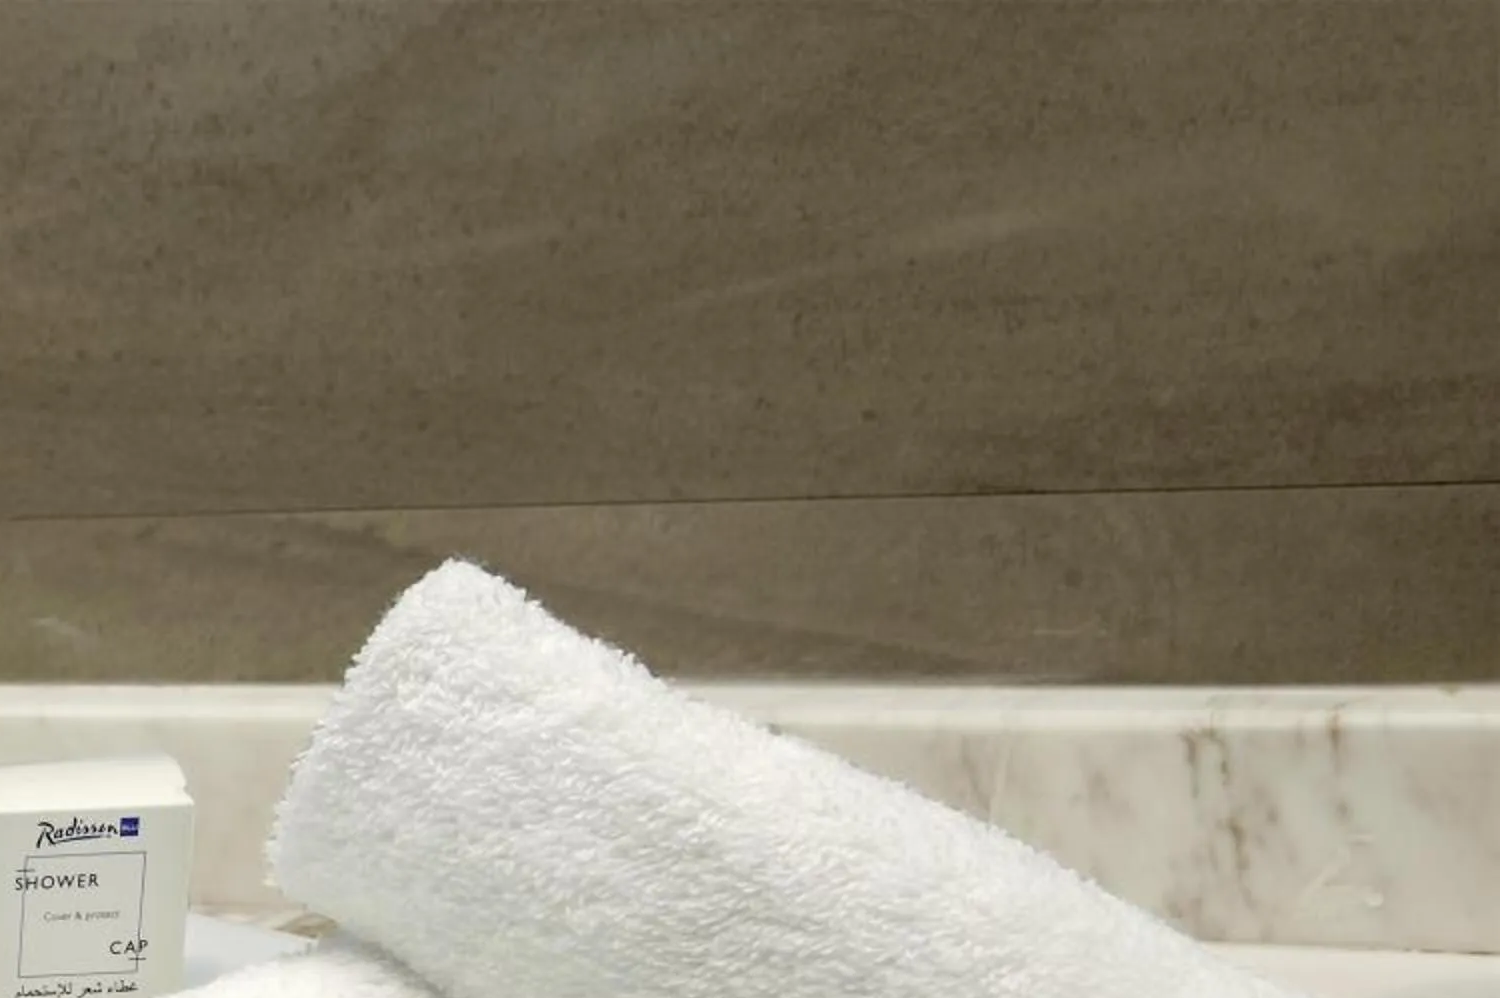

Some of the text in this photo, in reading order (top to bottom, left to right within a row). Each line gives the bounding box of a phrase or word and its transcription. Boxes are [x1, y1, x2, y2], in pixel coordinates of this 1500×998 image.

[36, 817, 119, 849] Radisson
[14, 873, 100, 891] SHOWER
[109, 939, 149, 955] CAP
